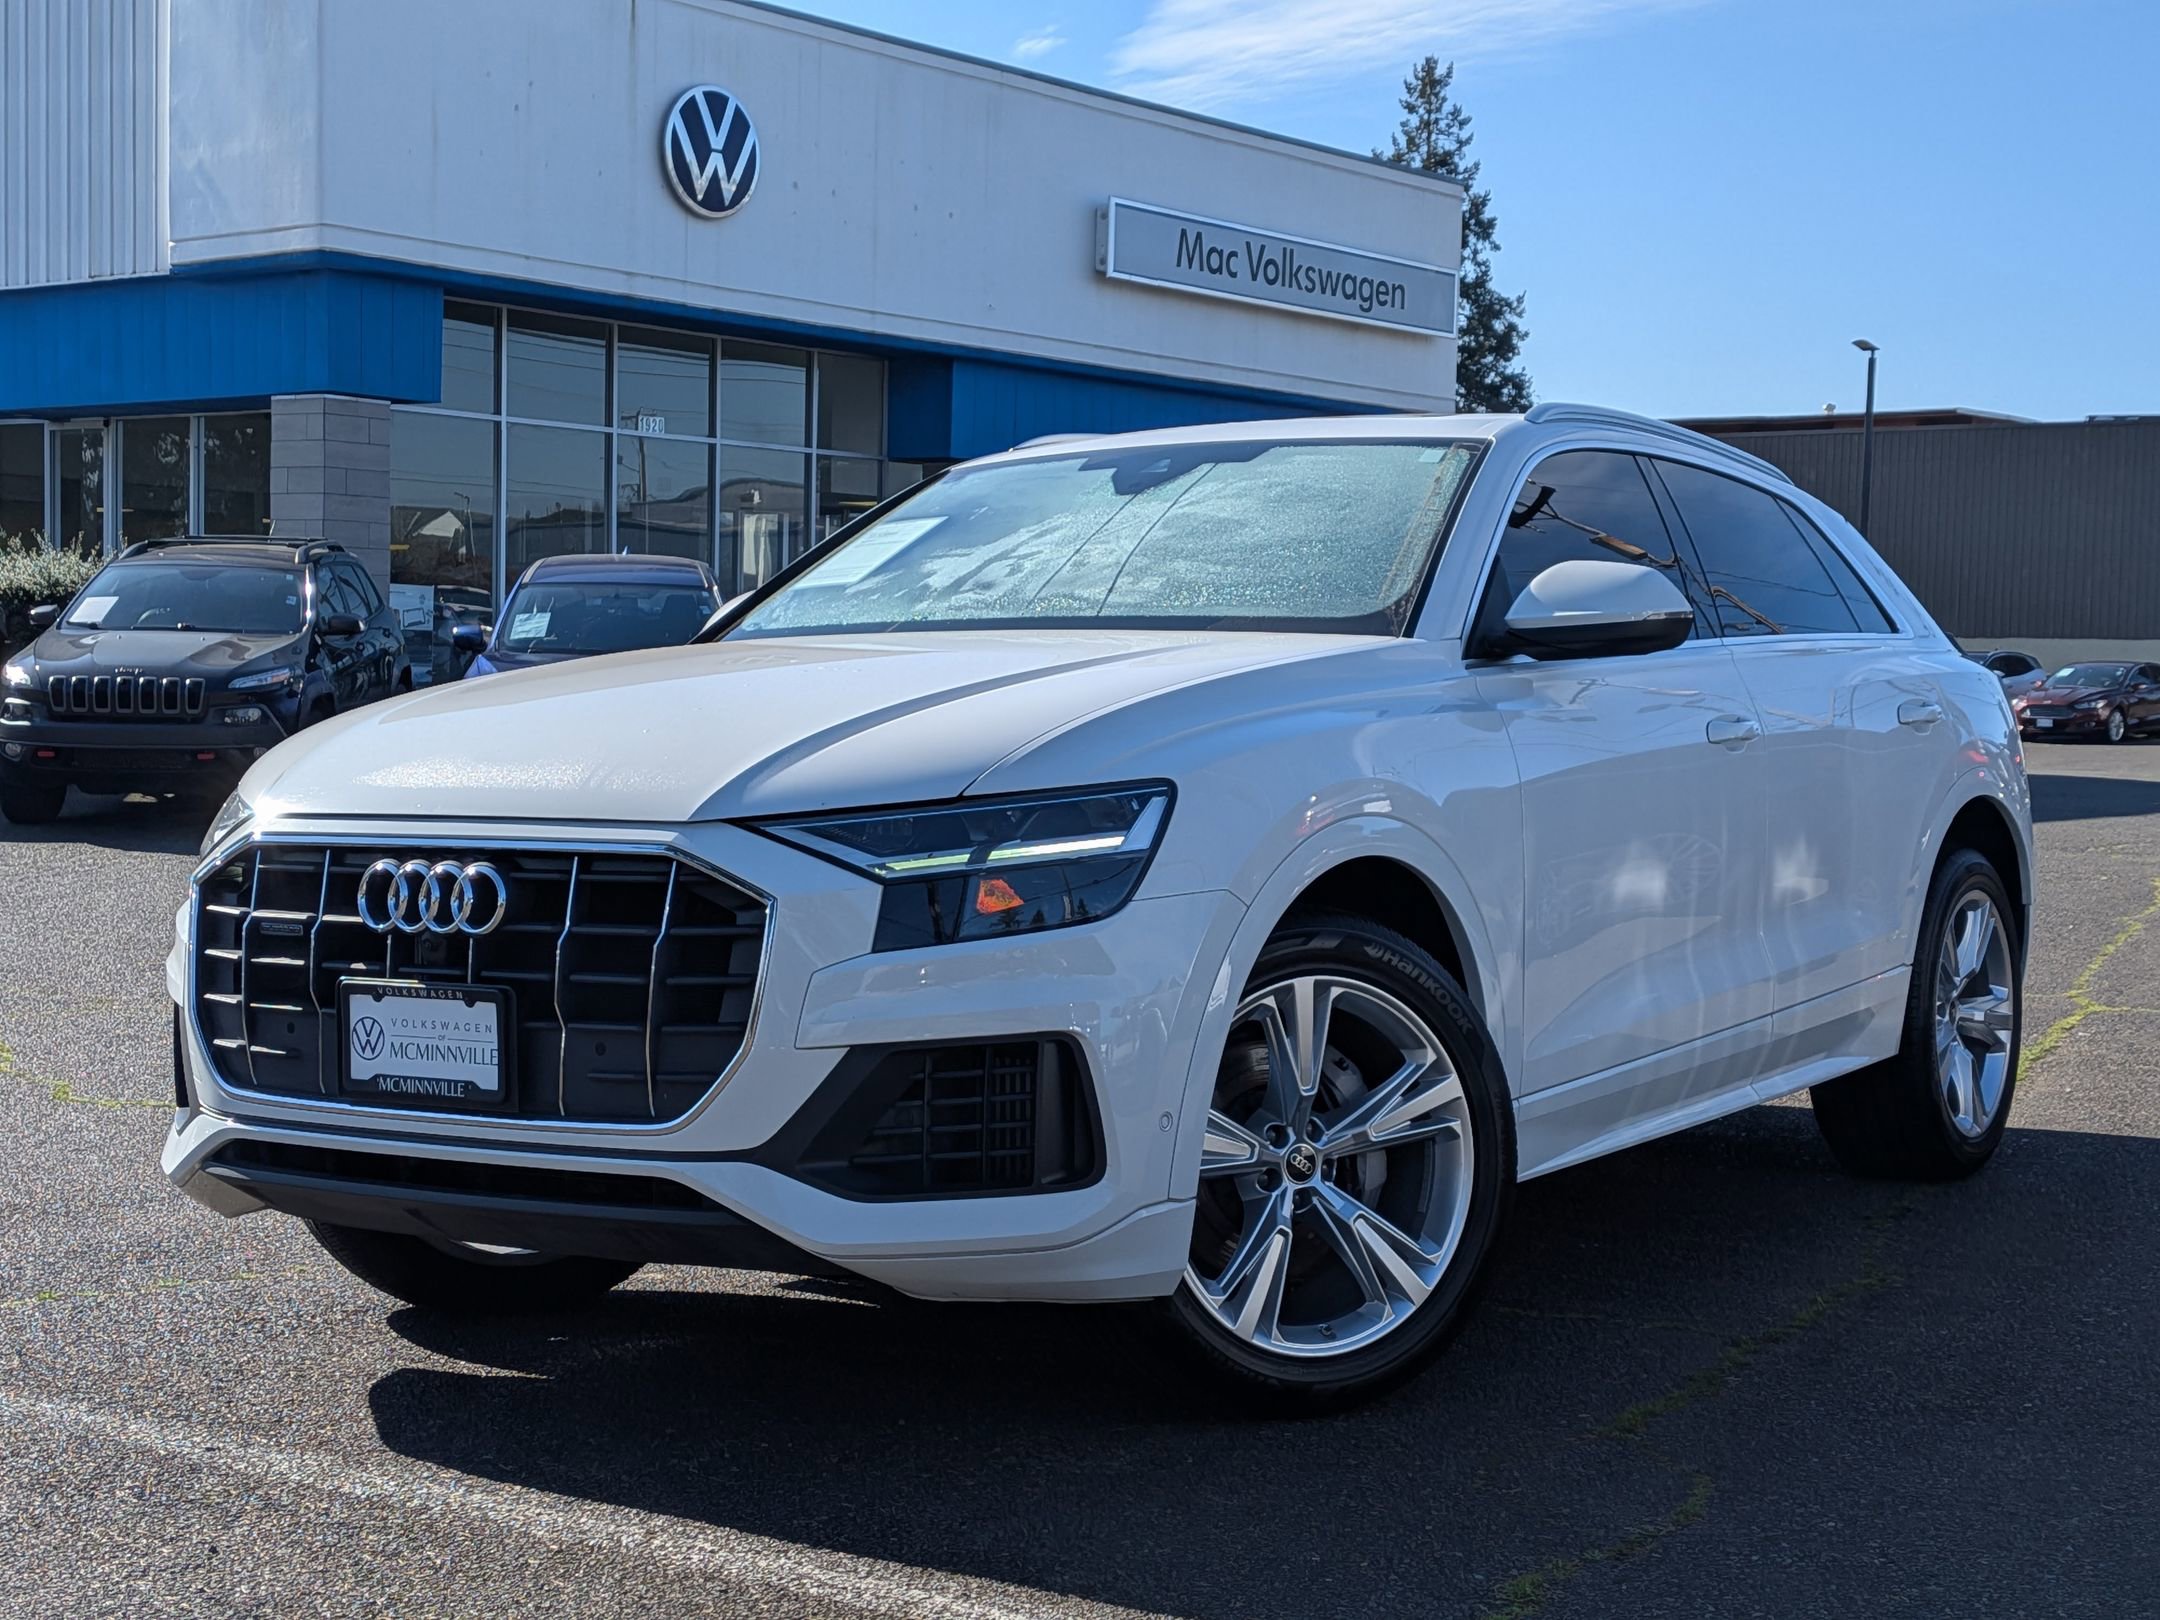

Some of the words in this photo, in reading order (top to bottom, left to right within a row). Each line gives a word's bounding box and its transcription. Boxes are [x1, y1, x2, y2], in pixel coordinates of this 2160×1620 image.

[1176, 228, 1239, 279] Mac
[1245, 240, 1406, 313] Volkswagen
[640, 416, 664, 432] 1920
[377, 986, 463, 999] VOLKSWAGEN
[390, 1018, 493, 1033] VOLKSWAGEN
[389, 1042, 499, 1066] MCMINNVILLE
[378, 1077, 465, 1097] MCMINNVILLE
